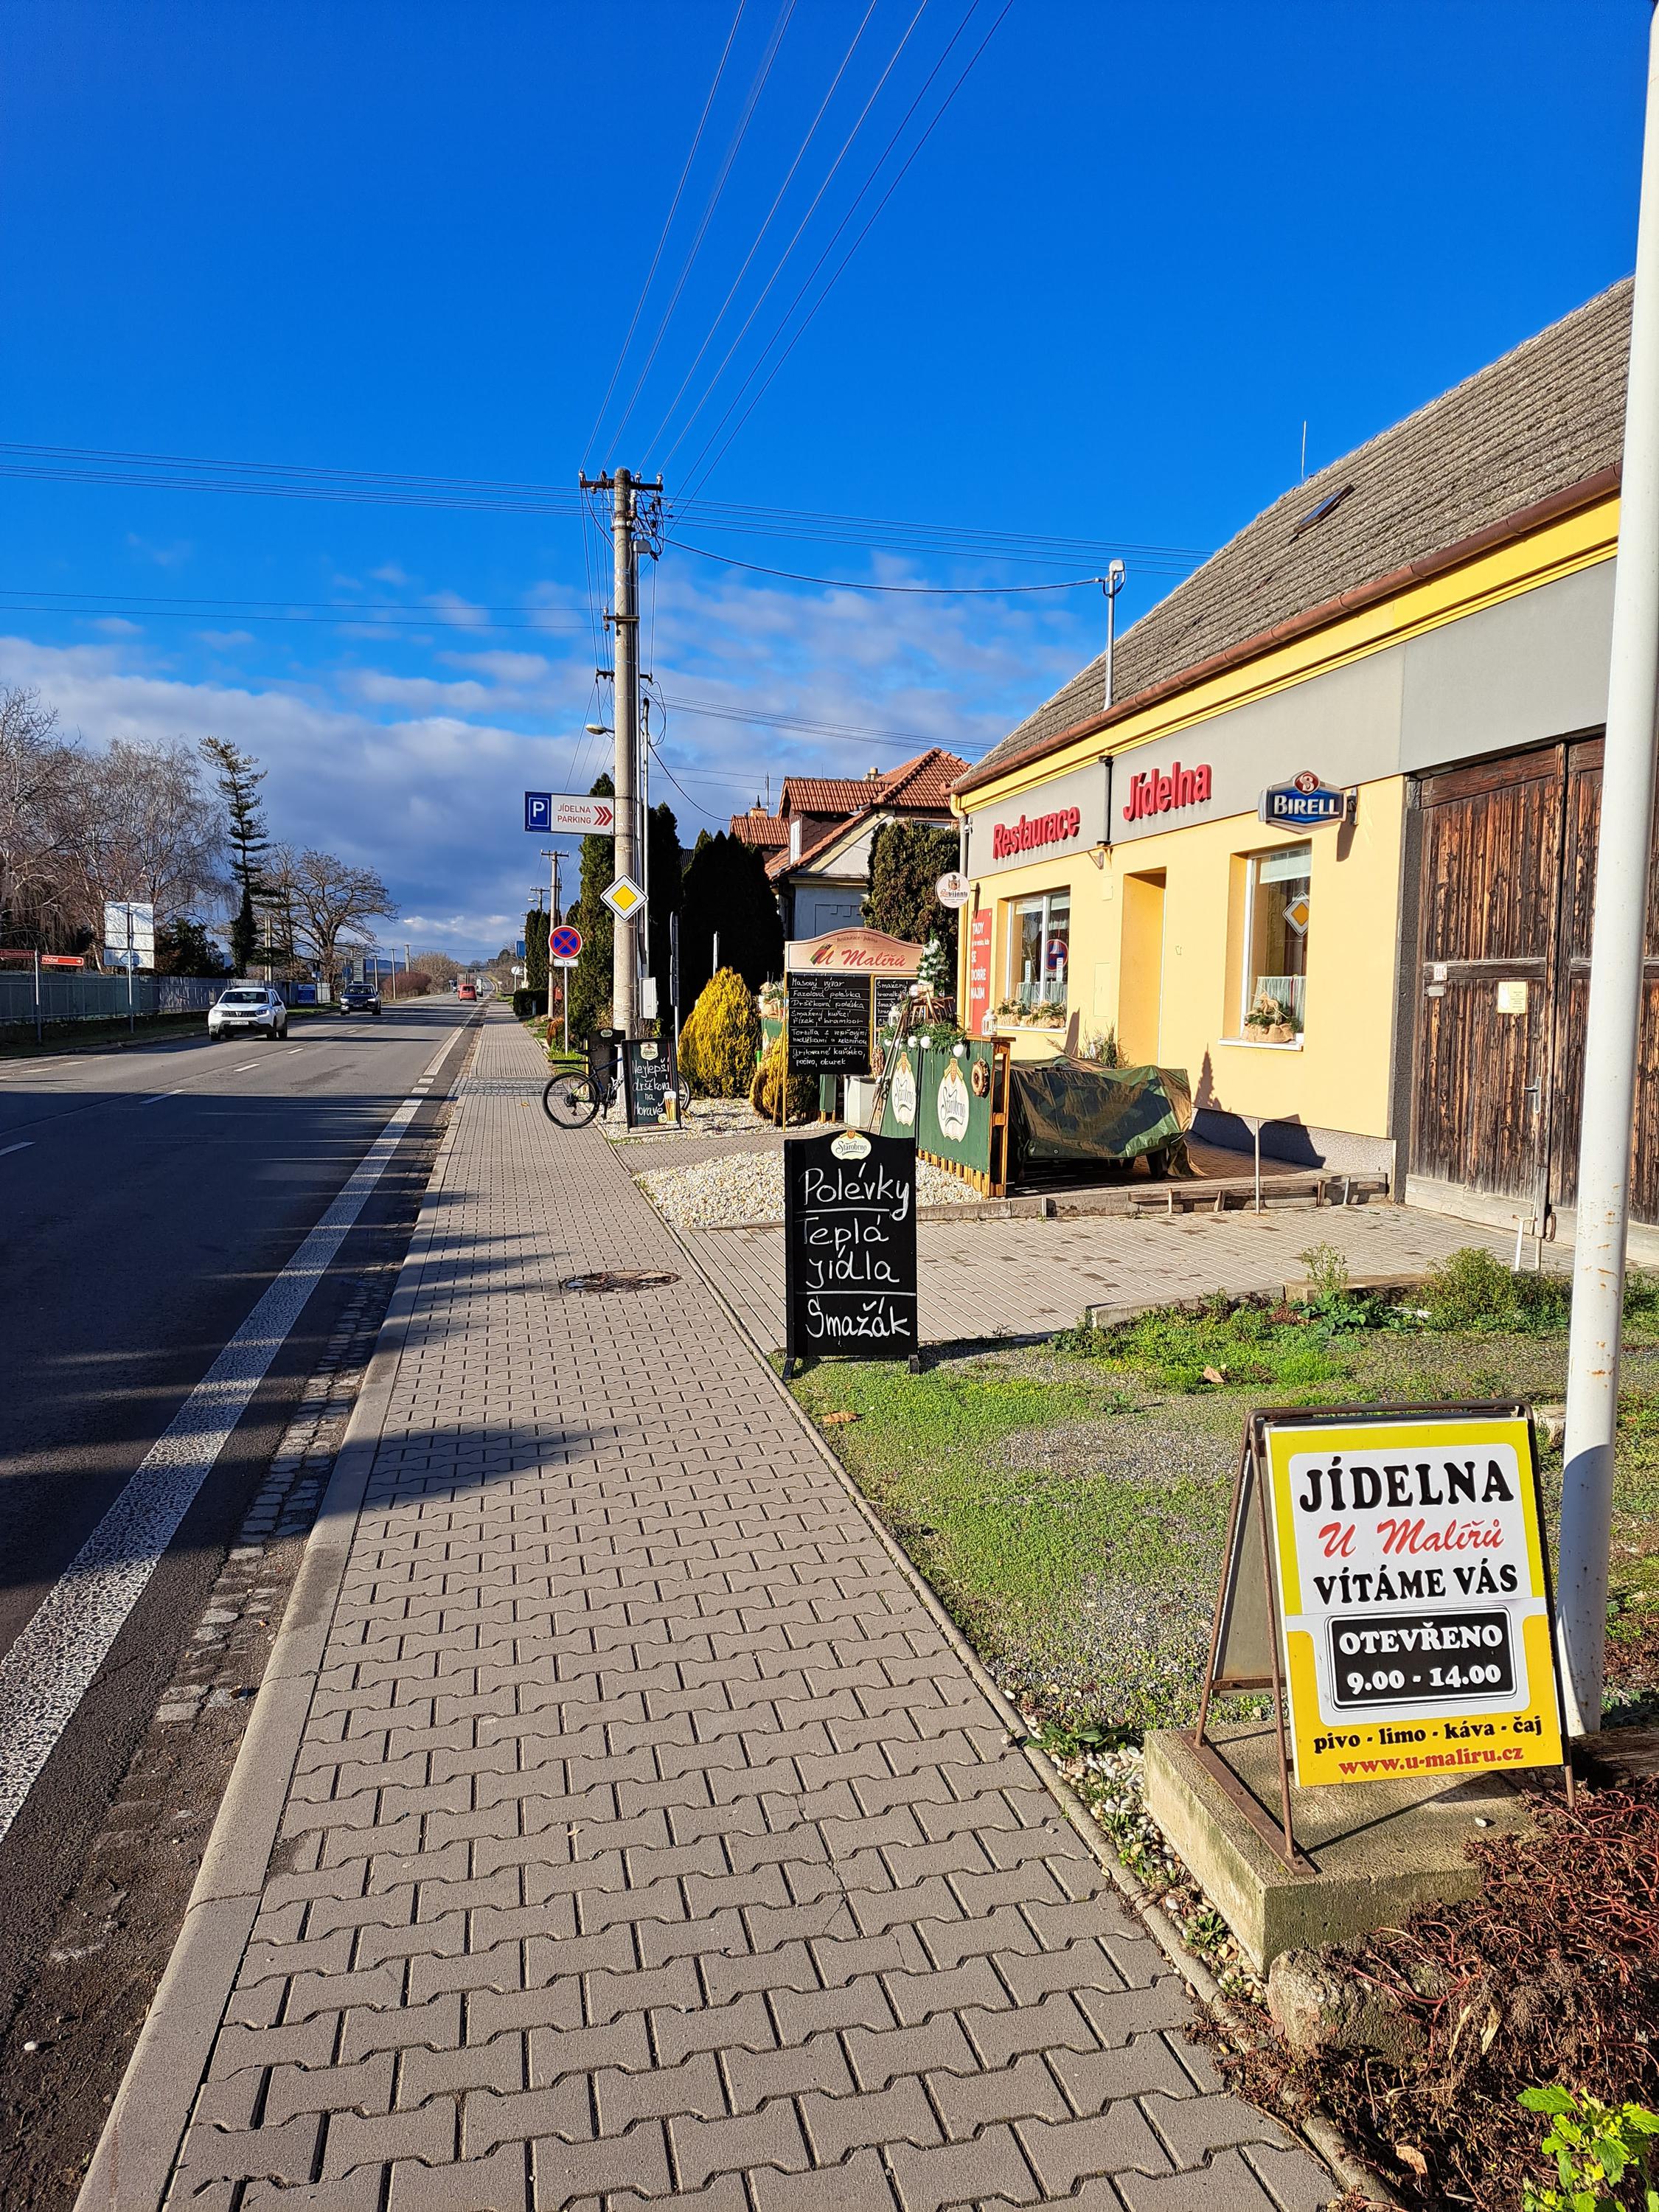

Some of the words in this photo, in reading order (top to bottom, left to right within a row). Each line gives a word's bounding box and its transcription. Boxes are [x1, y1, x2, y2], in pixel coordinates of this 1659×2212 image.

[1123, 762, 1212, 821] Jídelna
[533, 801, 545, 818] P
[557, 803, 591, 813] JÍDELNA
[1273, 795, 1340, 815] BIRELL
[557, 815, 591, 824] PARKING
[992, 807, 1081, 860] Restaurace
[972, 922, 984, 935] TADY
[841, 949, 908, 967] Malířů
[971, 950, 977, 964] SE
[824, 976, 844, 991] vývar
[970, 966, 987, 981] DOBŘE
[793, 990, 824, 998] Fazolová
[830, 989, 861, 998] polévka
[970, 984, 985, 999] NAJÍM
[644, 1093, 655, 1101] na
[835, 1140, 867, 1155] Starobrno
[799, 1162, 910, 1221] Polévky
[795, 1214, 889, 1251] Teplá
[805, 1295, 911, 1338] Smažák
[1299, 1455, 1515, 1512] JÍDELNA
[1318, 1522, 1357, 1558] U
[1377, 1517, 1505, 1555] Malířů
[1313, 1564, 1447, 1605] VÍTÁME
[1453, 1557, 1518, 1596] VÁS
[1339, 1621, 1503, 1655] OTEVŘENO
[1346, 1669, 1405, 1695] 9.00
[1429, 1664, 1502, 1688] 14.00
[1313, 1733, 1361, 1754] pivo
[1378, 1726, 1426, 1745] limo
[1444, 1720, 1496, 1740] káva
[1512, 1716, 1543, 1736] čaj
[1338, 1747, 1524, 1775] www.u-maliru.cz
